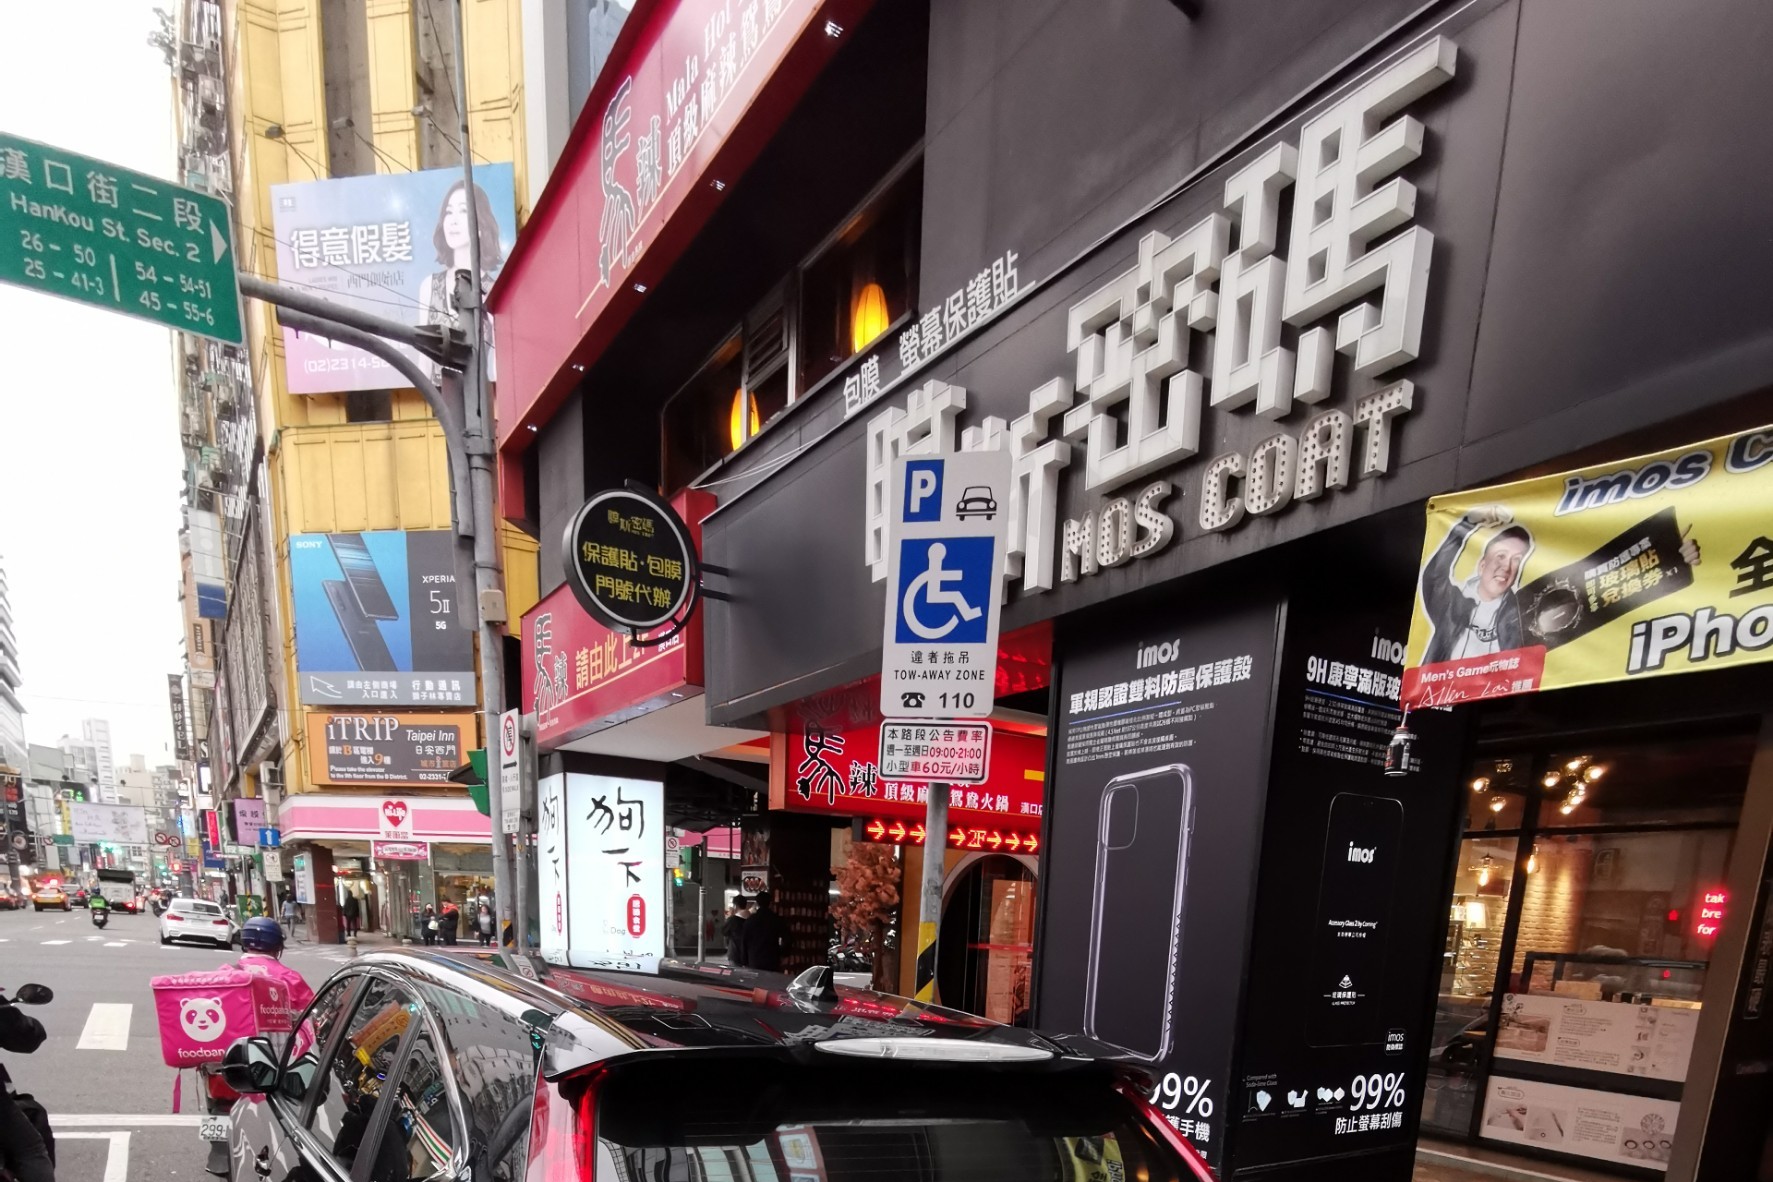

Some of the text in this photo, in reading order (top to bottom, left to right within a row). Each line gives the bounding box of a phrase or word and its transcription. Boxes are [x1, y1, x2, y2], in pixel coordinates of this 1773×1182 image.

[666, 55, 699, 126] Mala
[0, 147, 204, 235] 漢口街二段
[10, 191, 201, 263] HanKou St. Sec. 2
[20, 230, 44, 252] 26
[73, 243, 96, 267] 50
[290, 221, 413, 269] 得意假髮
[24, 258, 45, 280] 25
[135, 261, 158, 285] 54
[139, 291, 162, 311] 45
[843, 249, 1018, 419] 包膜 螢幕保護貼
[1200, 379, 1414, 532] COAT
[910, 470, 936, 513] P
[1554, 450, 1714, 517] imos
[296, 541, 323, 549] SONY
[422, 575, 456, 584] XPERIA
[595, 574, 672, 609] 門號代辦
[435, 621, 447, 630] 5G
[911, 650, 970, 664] 違者拖吊
[1136, 638, 1181, 670] imos
[894, 669, 985, 681] TOW-AWAY ZONE
[1069, 655, 1253, 715] 軍規認證雙料防震保護殼
[1421, 669, 1454, 683] Men's
[939, 692, 975, 708] 110
[328, 716, 399, 741] iTRIP
[406, 729, 455, 743] Taipei Inn
[887, 729, 983, 742] 本路段公告費率
[415, 745, 456, 756] 日安西門
[884, 782, 1009, 813] 頂級麻鴛鴦火鍋
[1347, 841, 1374, 863] imos
[1388, 1032, 1404, 1042] imos
[178, 1047, 225, 1059] foodpan
[1350, 1072, 1405, 1111] 99%
[1335, 1112, 1403, 1135] 防止螢幕刮傷
